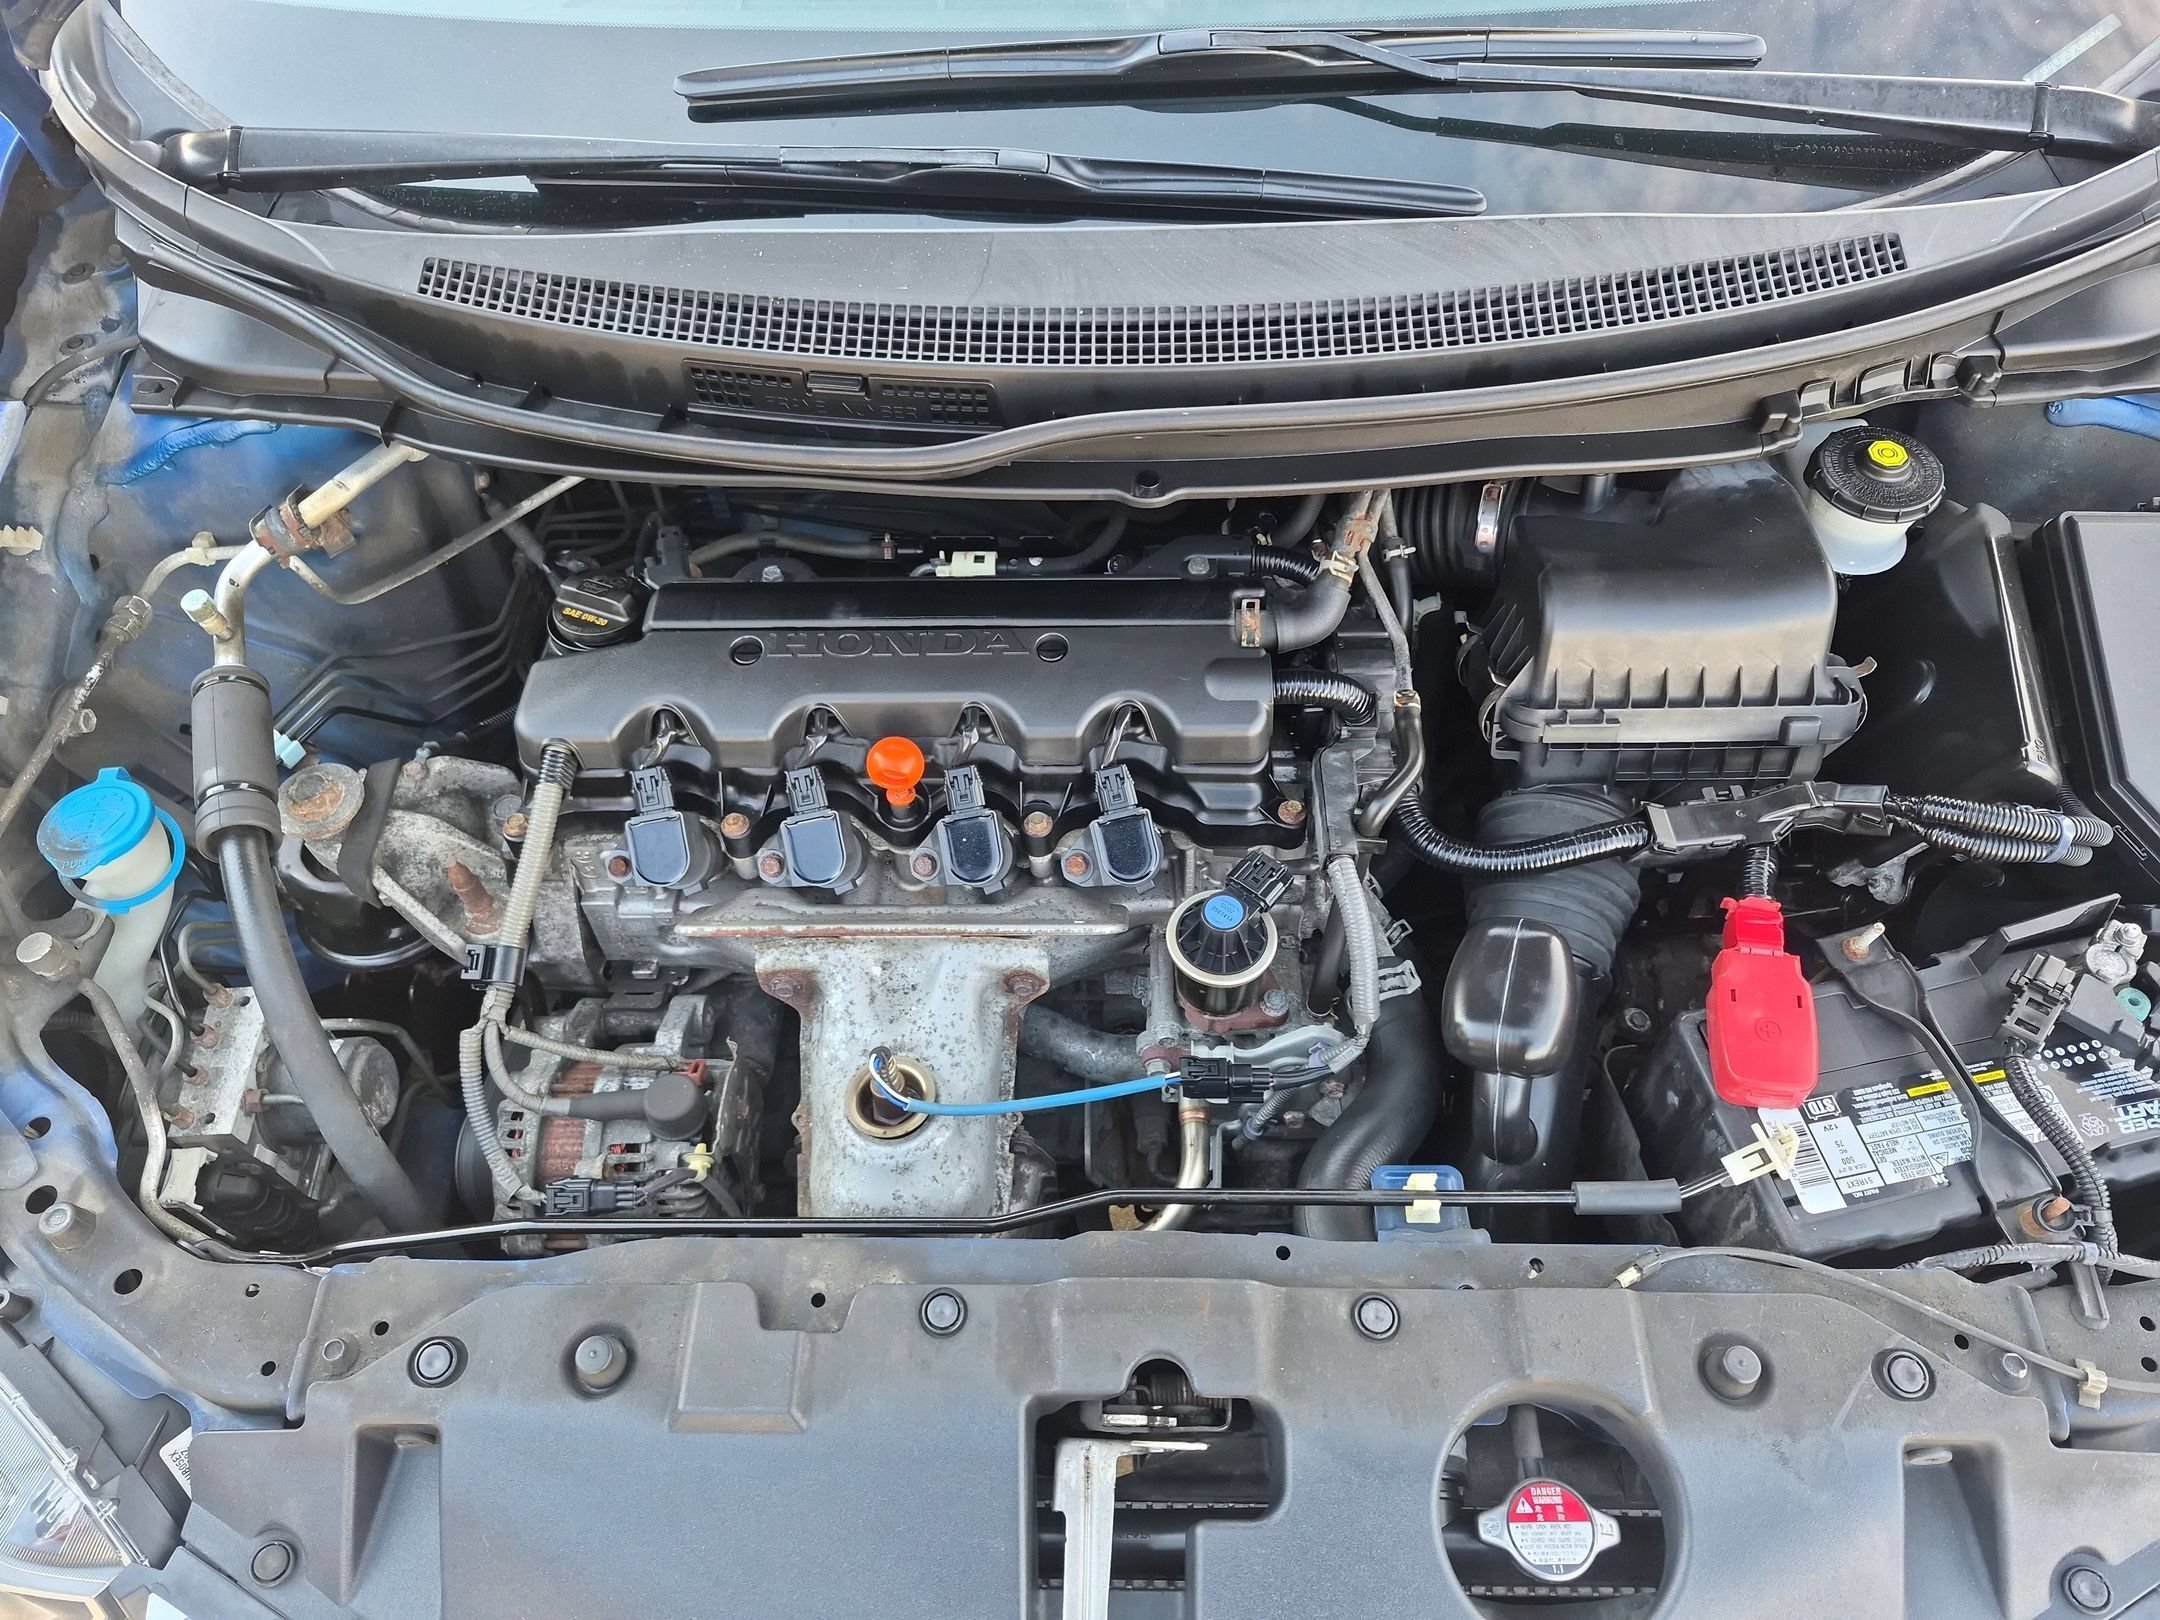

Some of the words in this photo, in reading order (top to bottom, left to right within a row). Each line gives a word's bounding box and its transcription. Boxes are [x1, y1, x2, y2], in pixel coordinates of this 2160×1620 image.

[562, 607, 583, 619] SAE
[581, 613, 609, 626] 0W-20
[767, 630, 1030, 657] HONDA
[1808, 1099, 1836, 1115] STD
[1825, 1124, 1838, 1132] 12V
[1872, 1148, 1897, 1157] MEDICAL
[1841, 1157, 1855, 1165] 500
[1893, 1161, 1930, 1174] IMMEDIATELY
[1915, 1168, 1933, 1176] FLUSH
[1847, 1177, 1873, 1189] 51REXT
[1530, 1487, 1561, 1496] DANGER
[1551, 1564, 1564, 1574] 1.1
